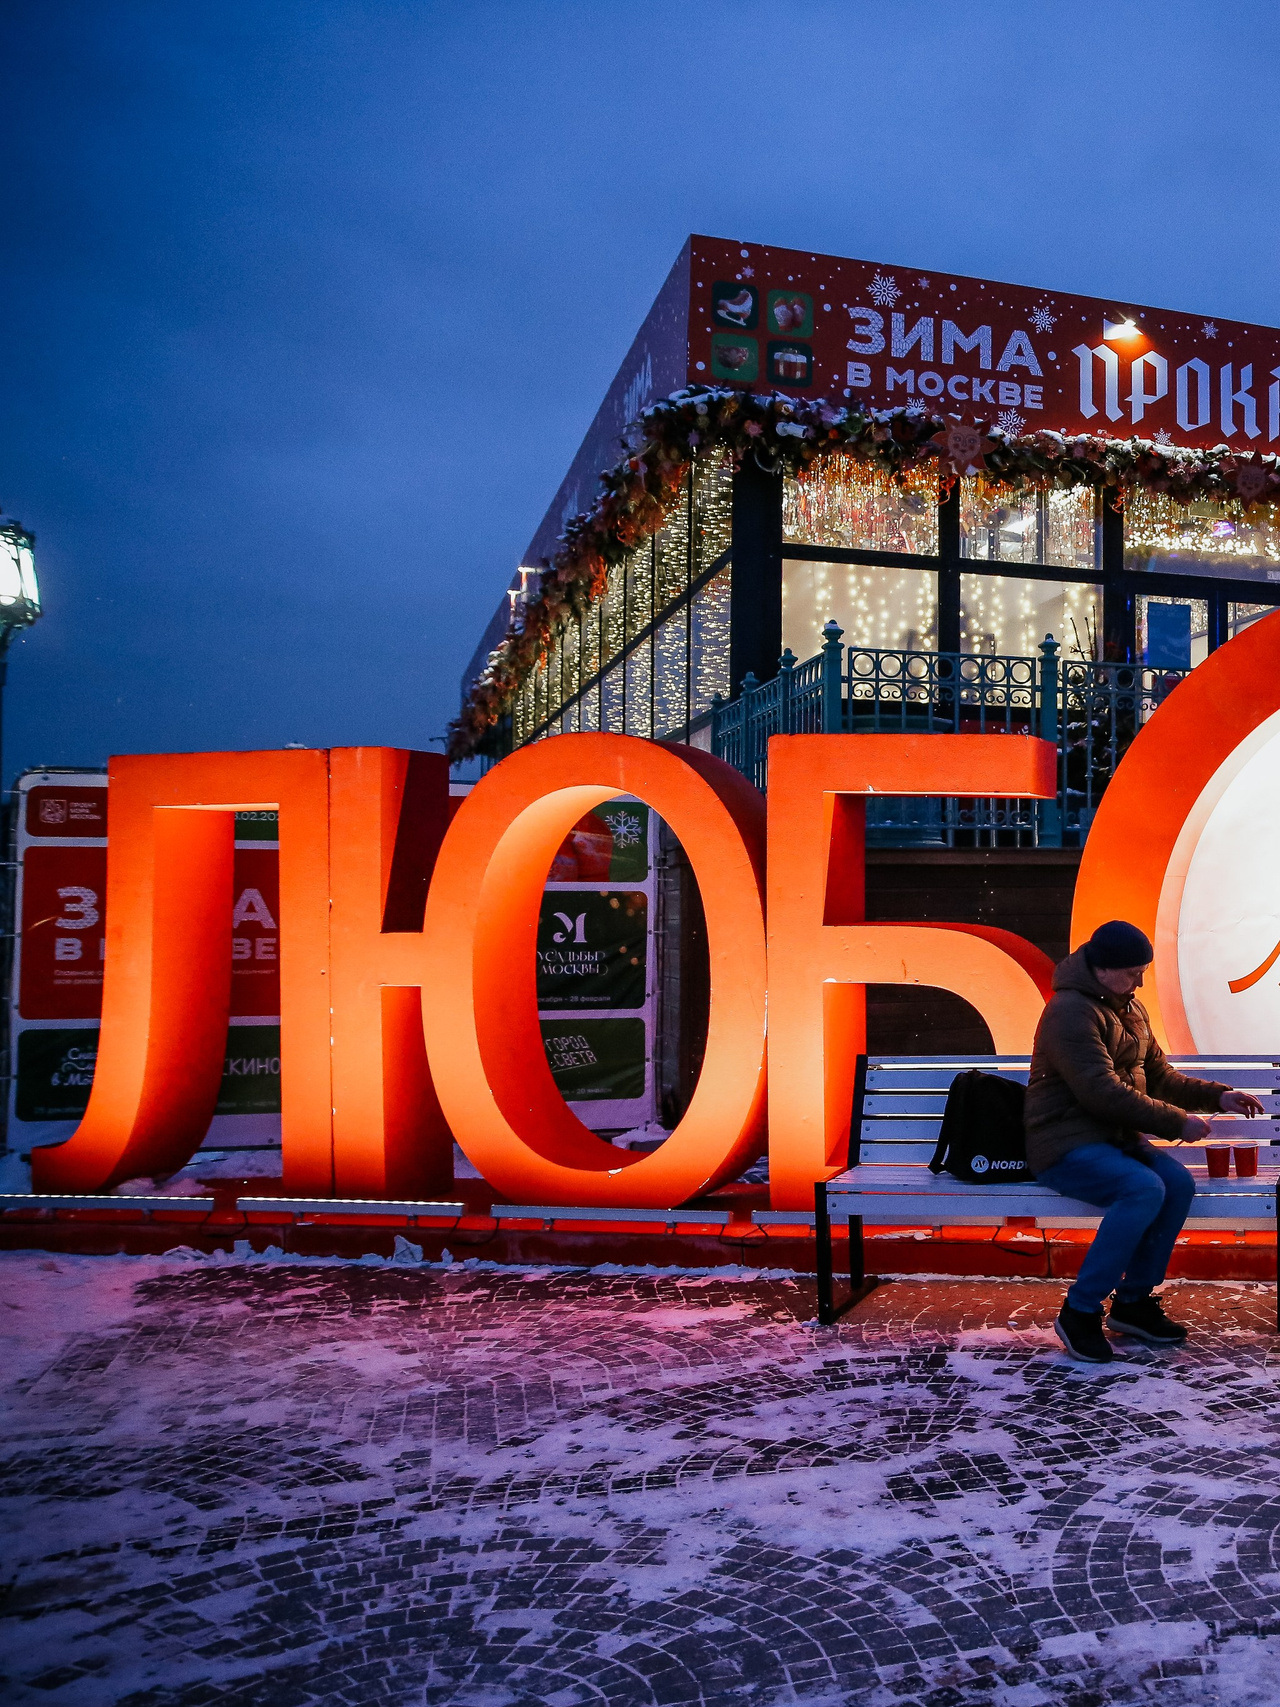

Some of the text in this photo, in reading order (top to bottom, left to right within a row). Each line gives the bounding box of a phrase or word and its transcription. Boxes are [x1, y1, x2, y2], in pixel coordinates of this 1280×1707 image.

[846, 306, 1044, 377] ЗИМА
[846, 361, 1044, 410] В МОСКВЕ
[55, 937, 83, 961] В
[545, 1035, 590, 1051] ГОРОД
[223, 1057, 281, 1076] КИНО
